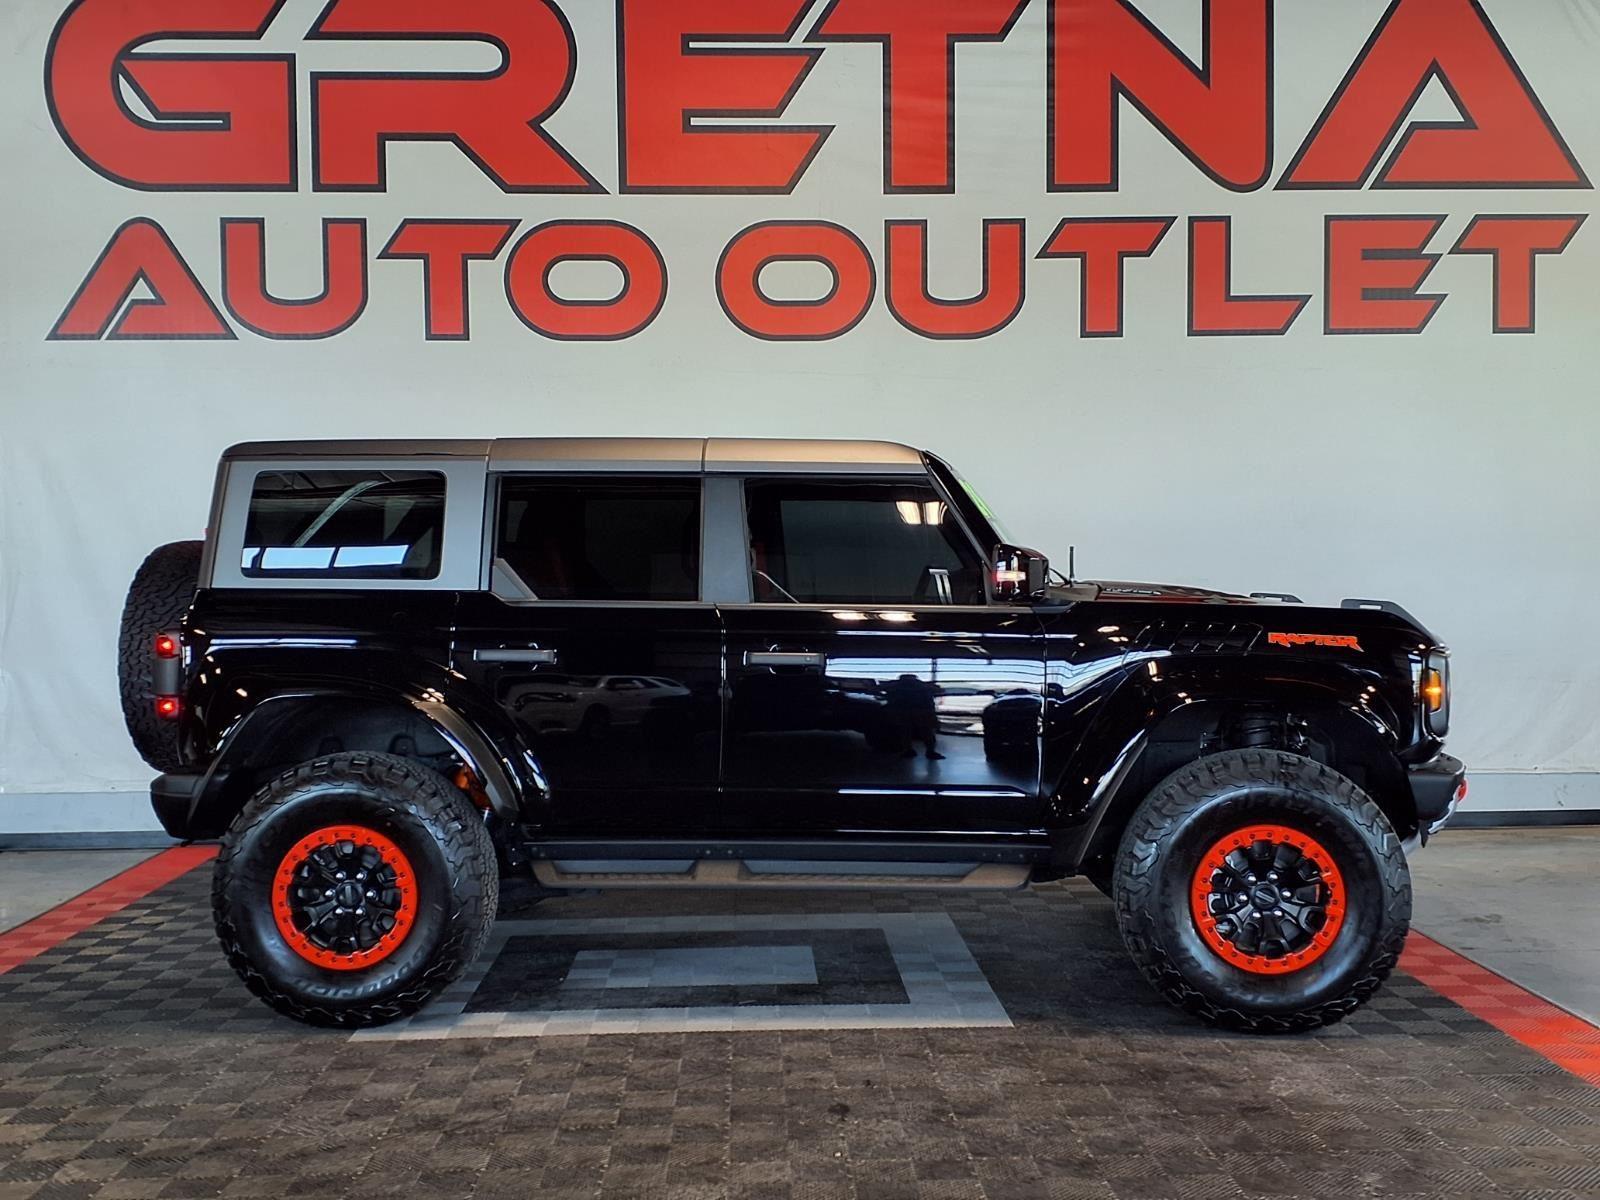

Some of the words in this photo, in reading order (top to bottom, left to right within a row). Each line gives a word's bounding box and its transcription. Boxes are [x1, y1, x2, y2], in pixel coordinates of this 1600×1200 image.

[45, 0, 1594, 194] GRETNA
[46, 216, 669, 341] AUTO
[715, 213, 1589, 341] OUTLET
[1268, 632, 1365, 652] RAPTOR
